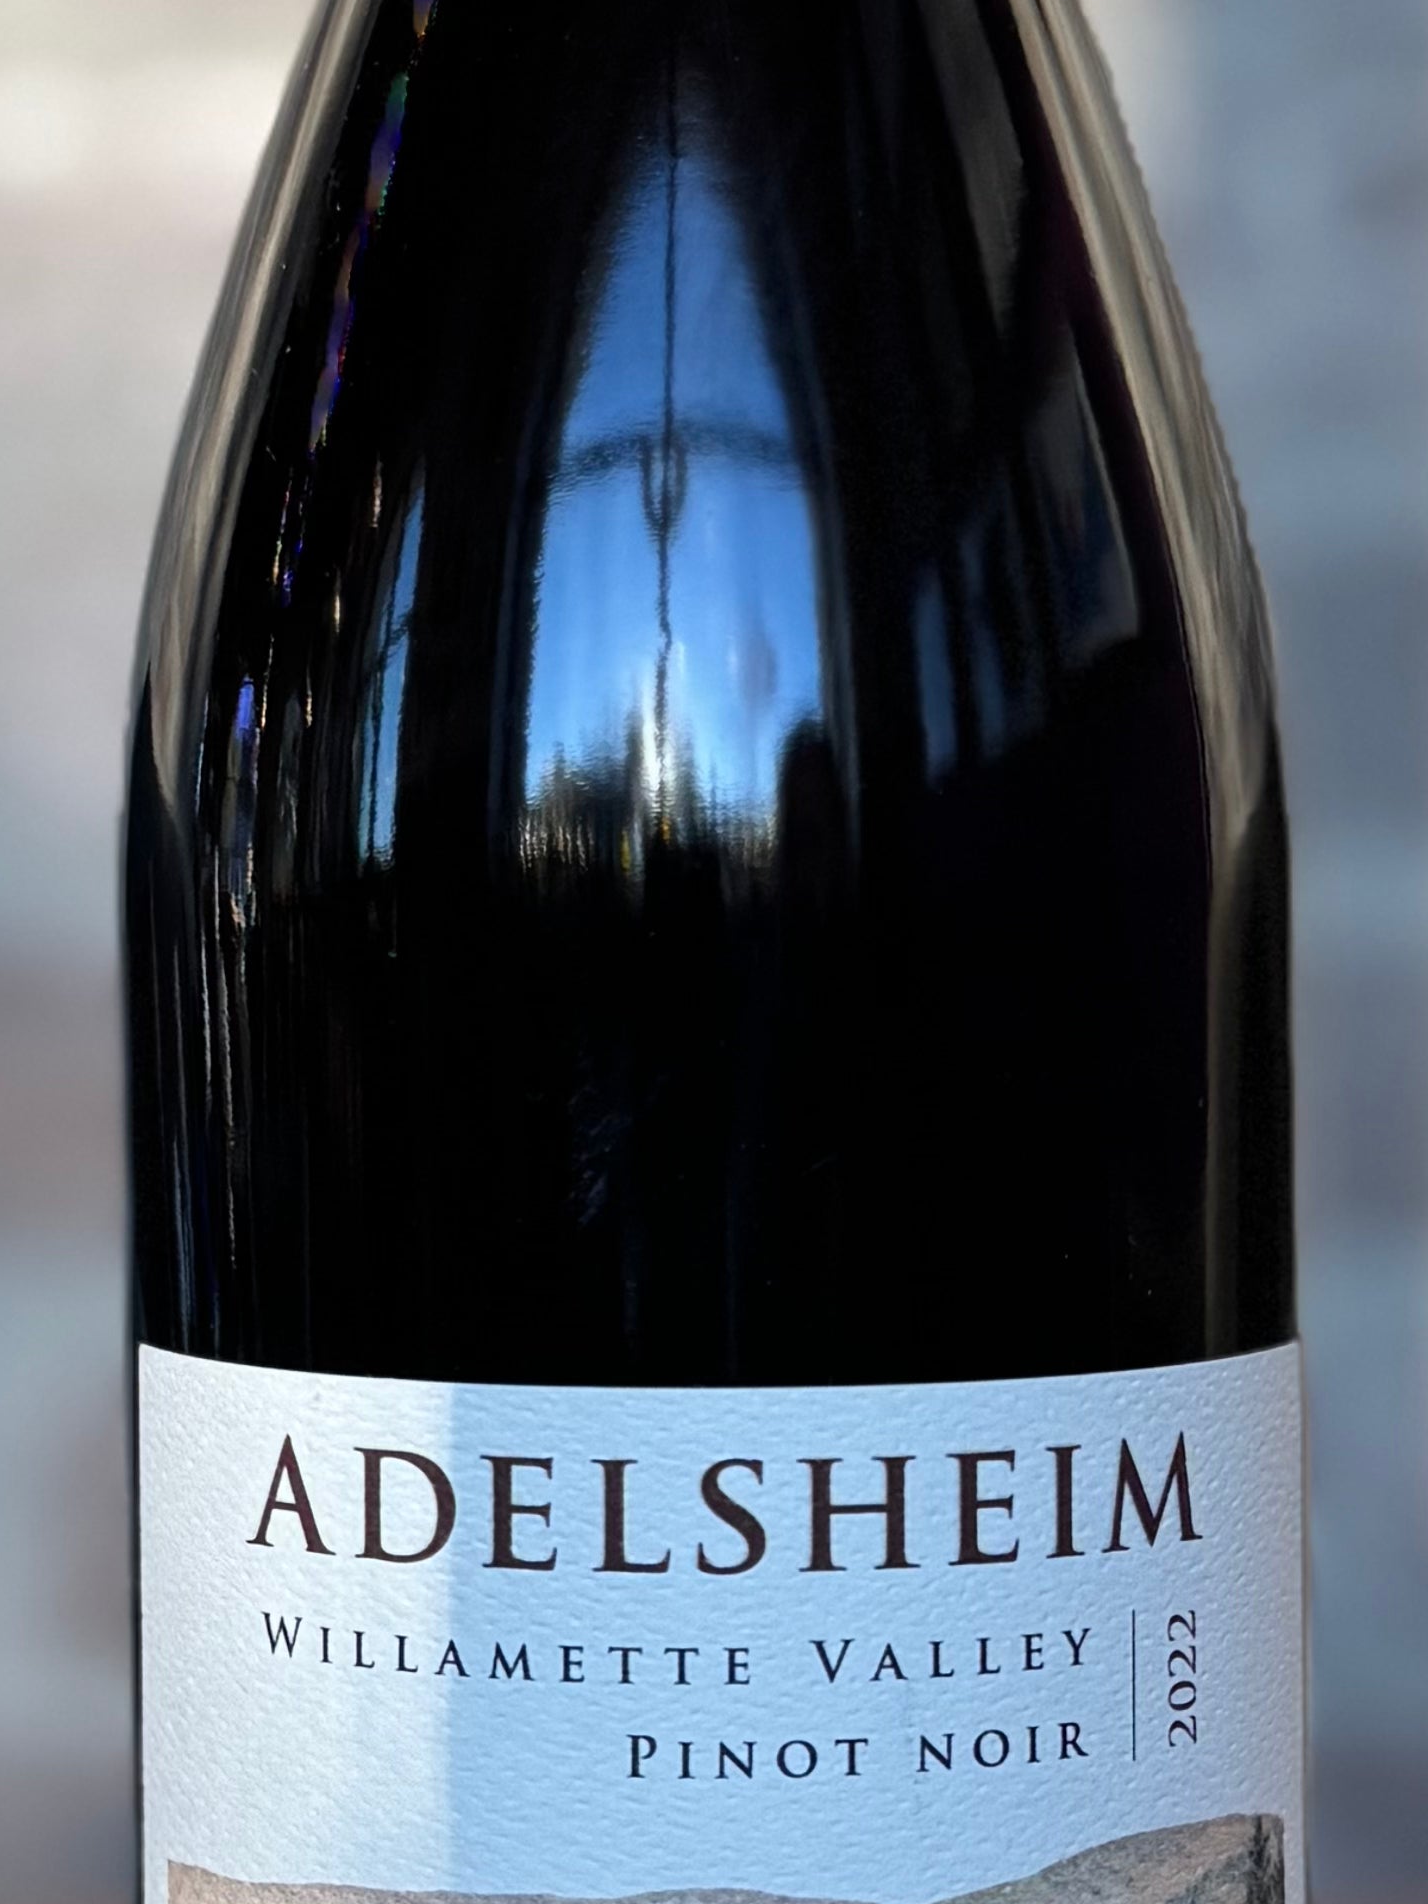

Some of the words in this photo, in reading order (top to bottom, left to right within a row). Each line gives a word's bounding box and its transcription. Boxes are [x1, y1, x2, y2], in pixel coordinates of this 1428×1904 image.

[244, 1429, 1205, 1577] ADELSHEIM
[260, 1610, 753, 1687] WILLAMETTE
[808, 1626, 1094, 1685] VALLEY
[1165, 1608, 1199, 1749] 2022
[624, 1733, 871, 1781] PINOT
[914, 1720, 1092, 1775] NOIR
